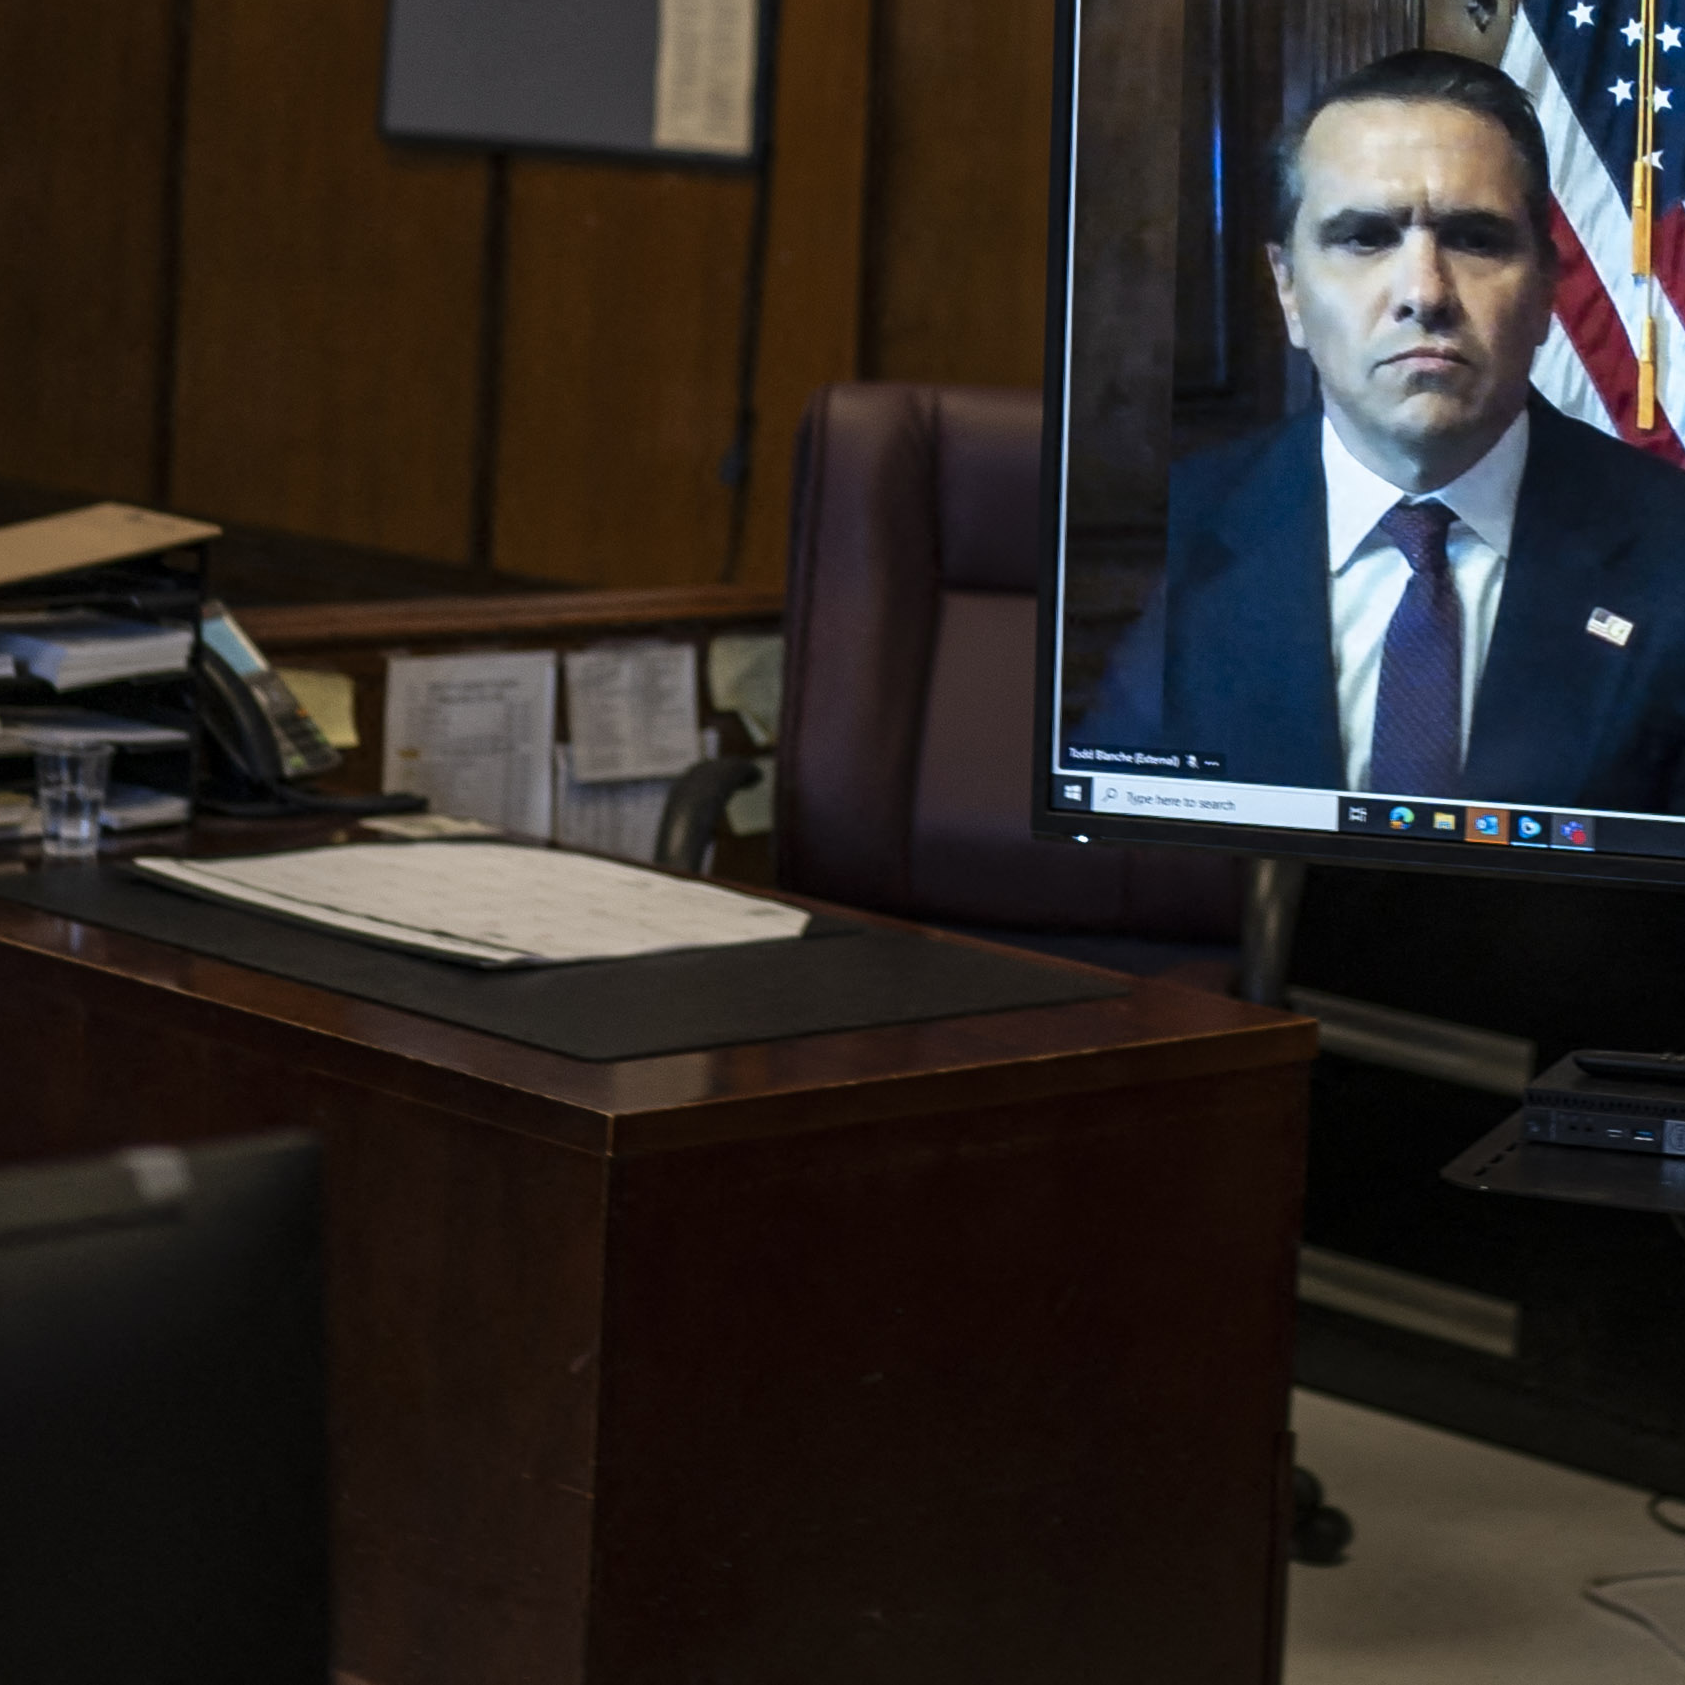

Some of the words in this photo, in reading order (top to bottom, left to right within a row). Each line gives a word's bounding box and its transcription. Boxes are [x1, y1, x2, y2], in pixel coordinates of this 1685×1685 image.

[1069, 746, 1094, 760] Todd
[1095, 749, 1133, 764] Blanche
[1134, 752, 1181, 768] (External)
[1126, 791, 1154, 805] Type
[1155, 793, 1181, 806] here
[1183, 796, 1195, 808] to
[1198, 799, 1236, 811] search
